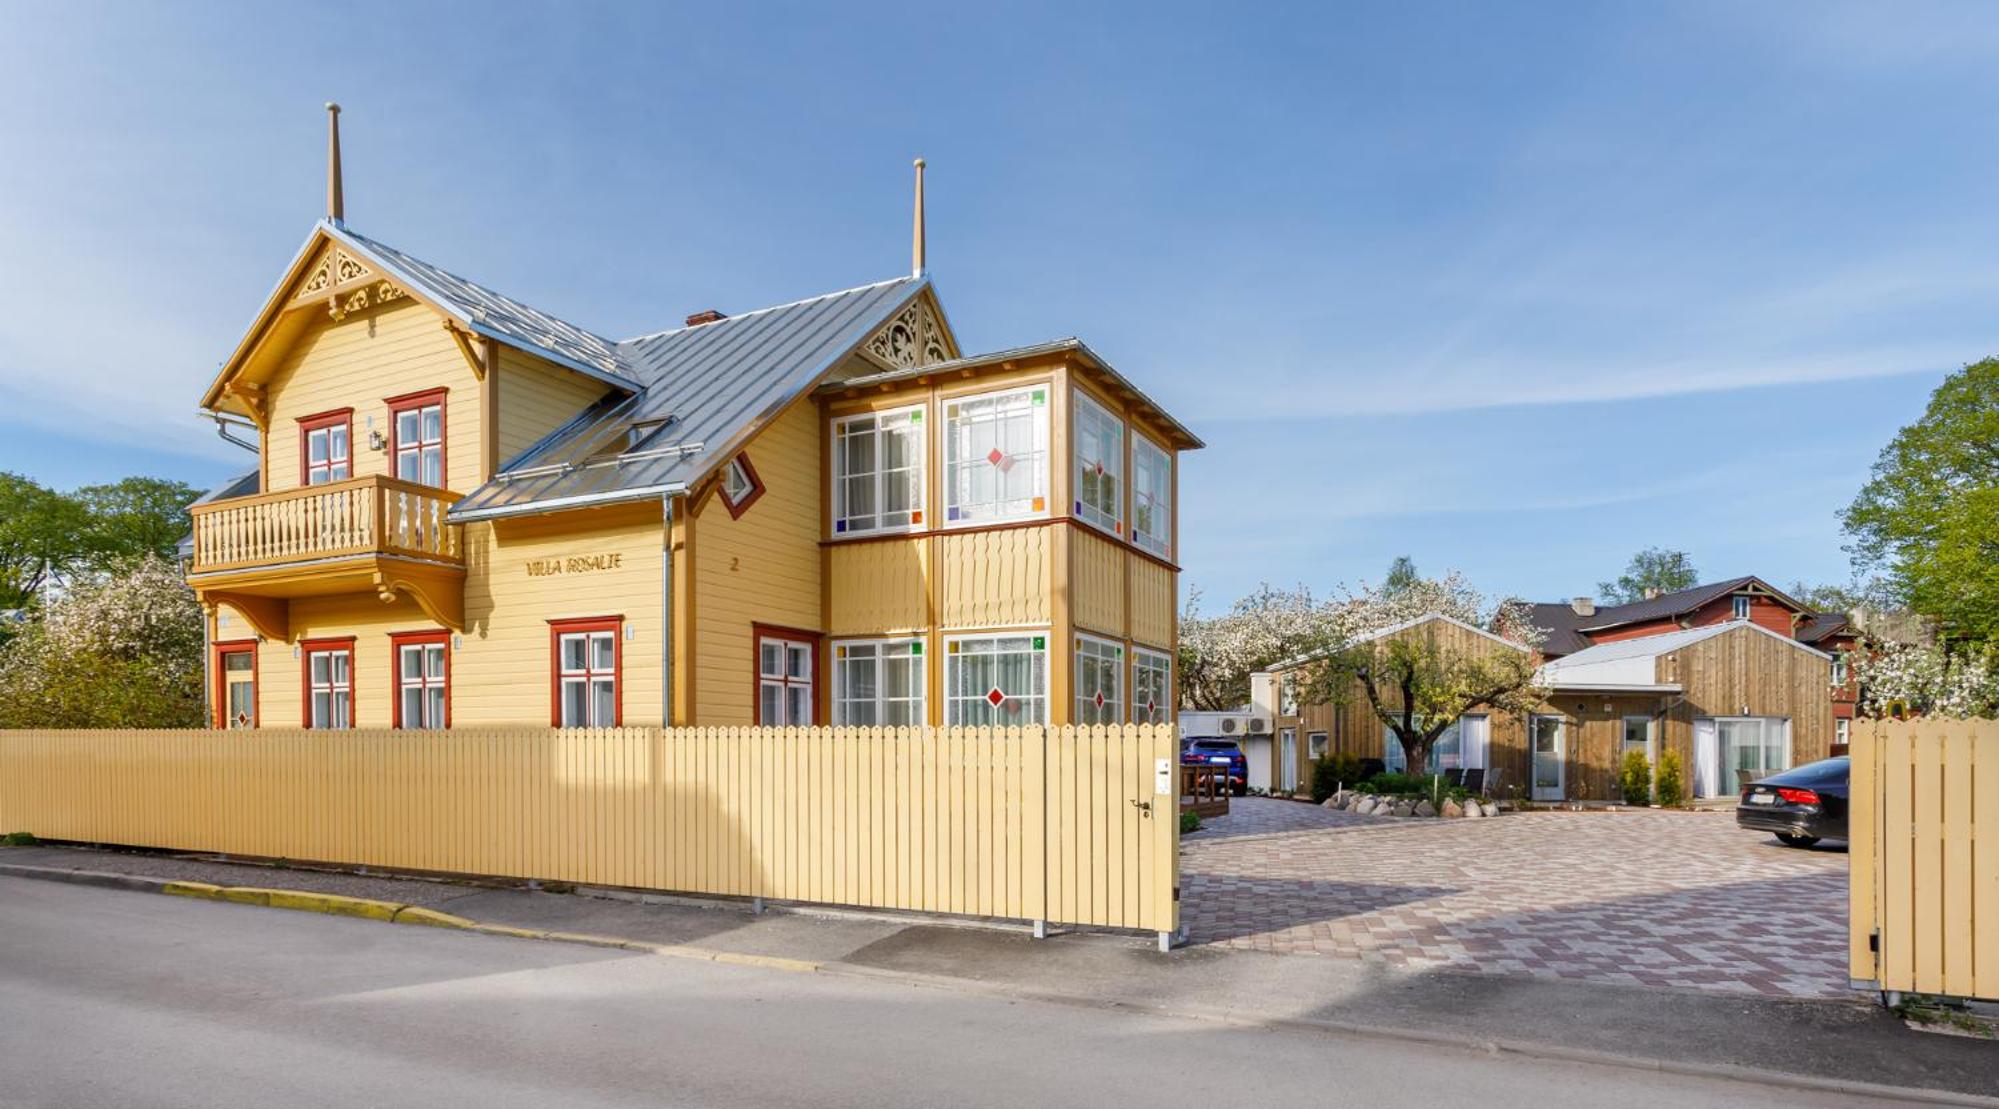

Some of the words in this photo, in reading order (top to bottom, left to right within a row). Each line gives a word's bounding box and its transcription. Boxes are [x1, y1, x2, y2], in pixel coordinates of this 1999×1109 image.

[526, 560, 562, 576] VILLA
[566, 553, 622, 573] ROSALIE
[730, 557, 739, 572] 2
